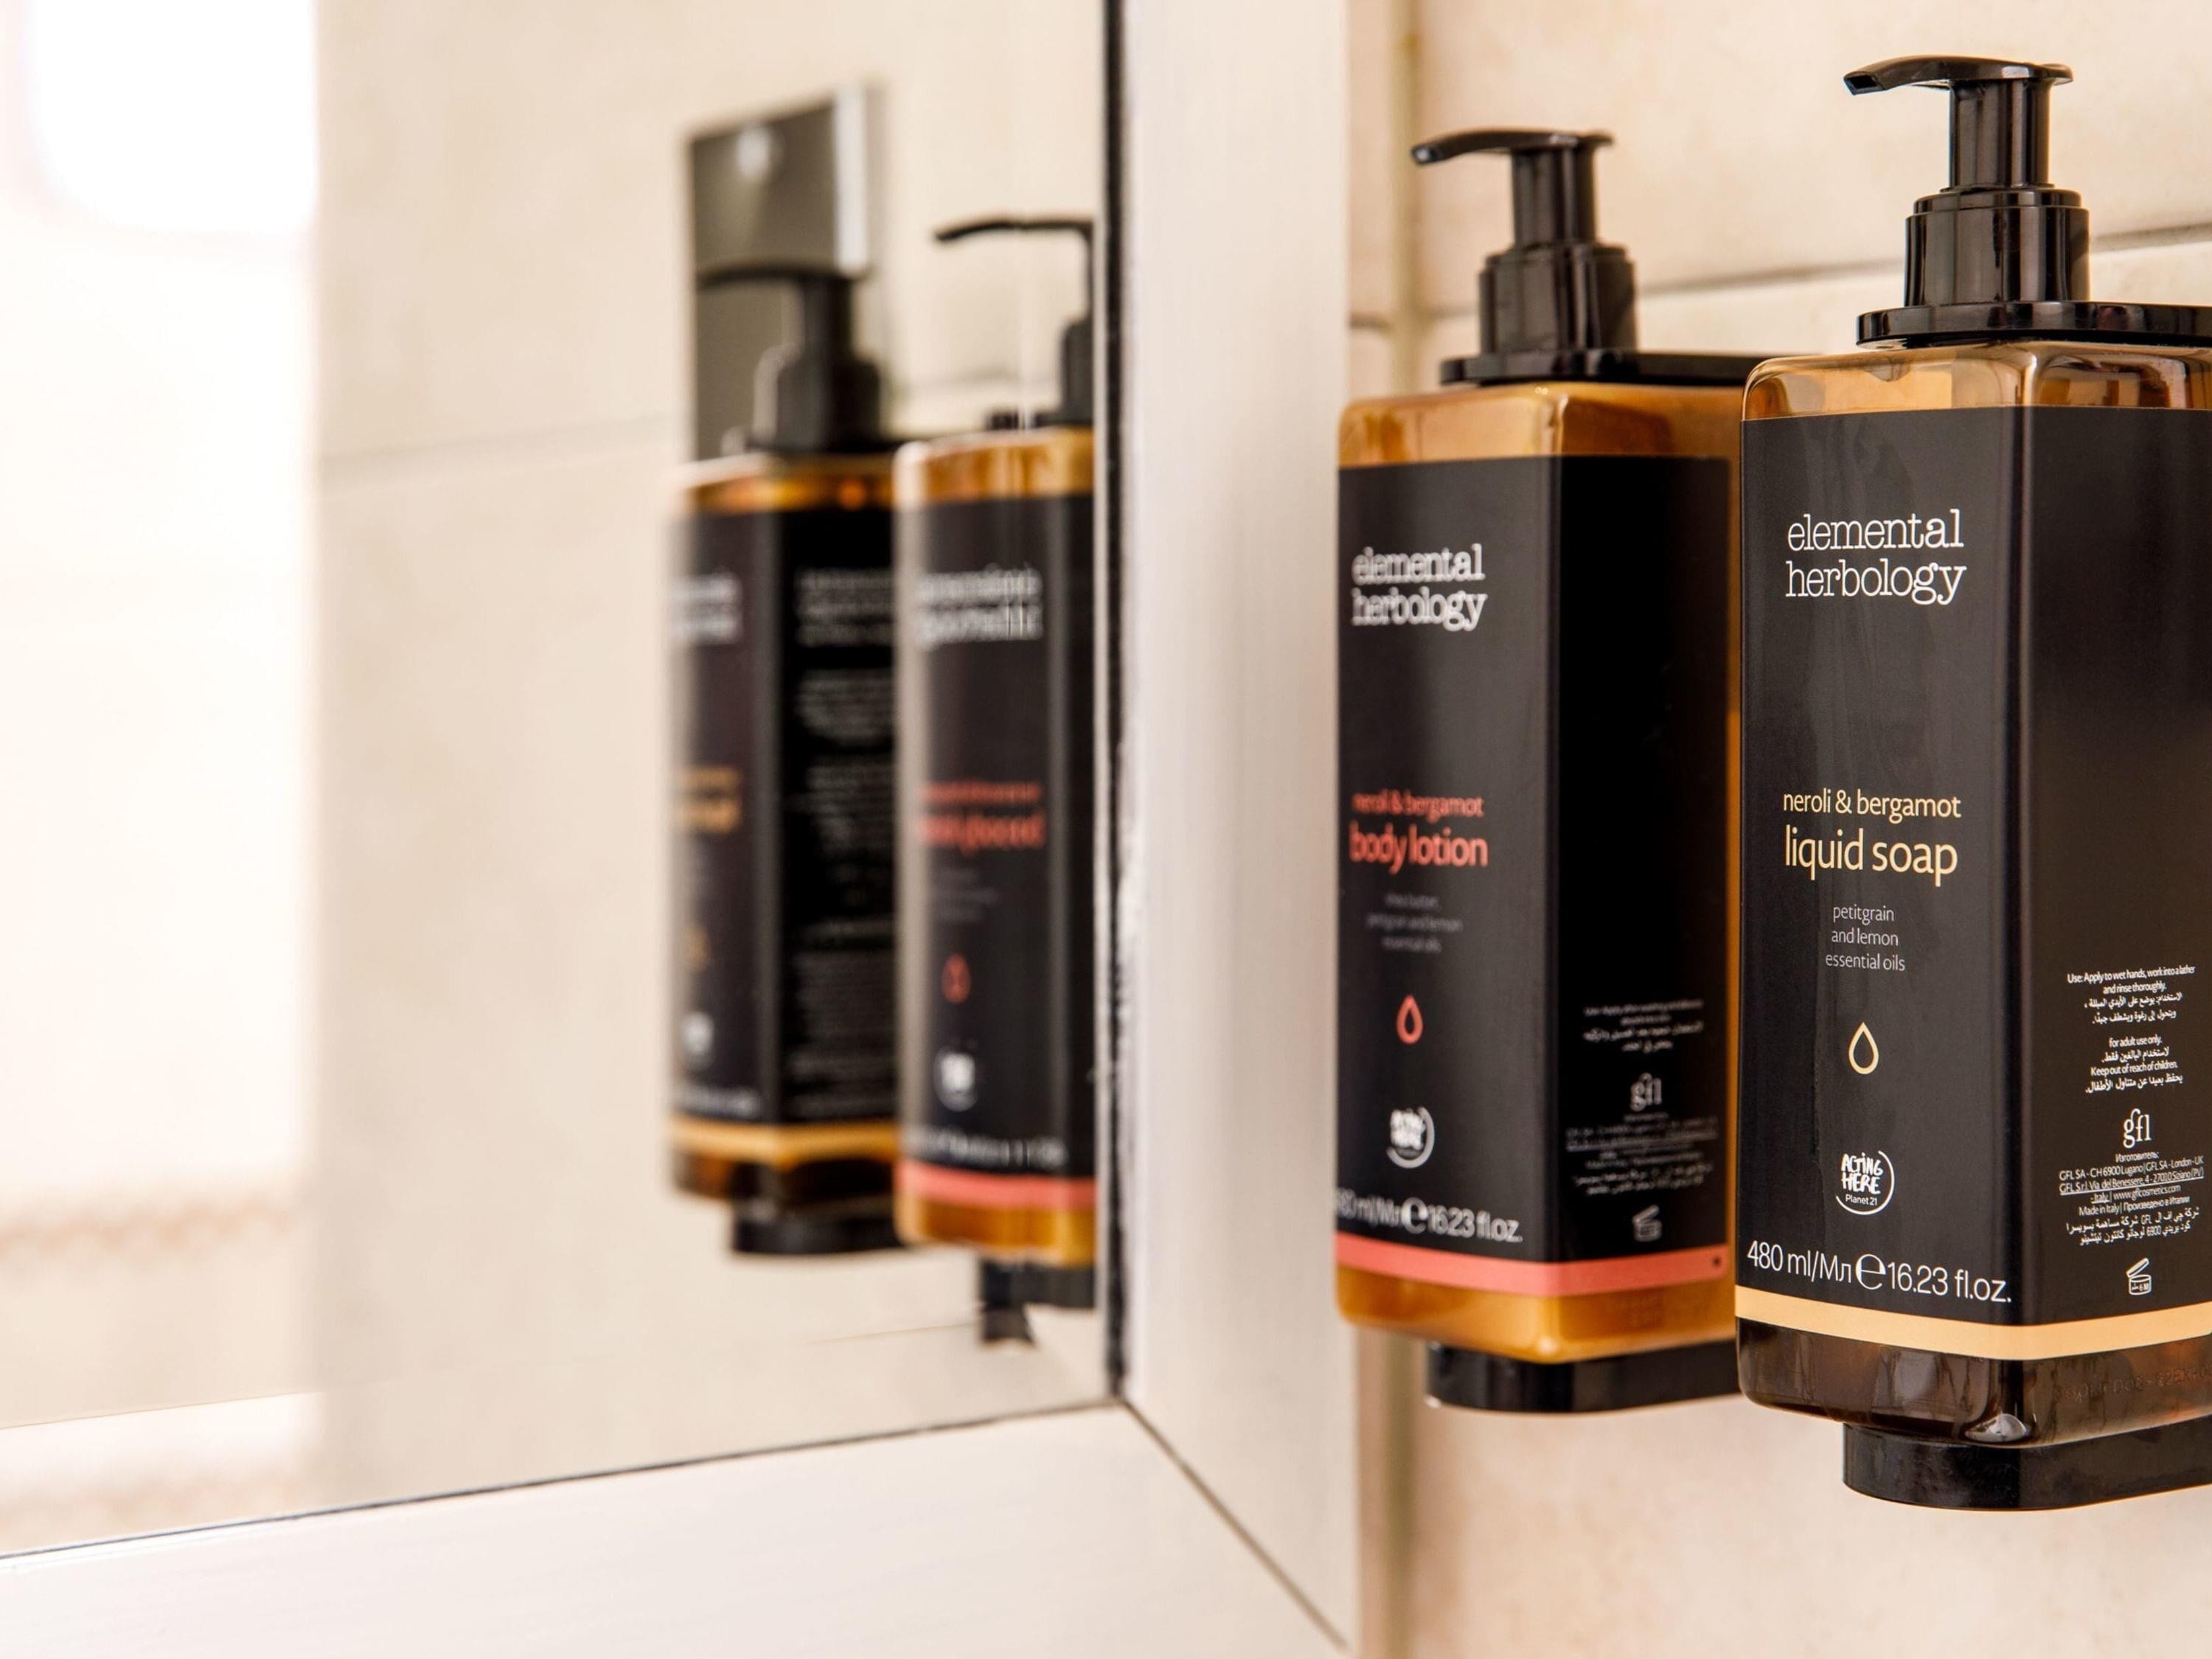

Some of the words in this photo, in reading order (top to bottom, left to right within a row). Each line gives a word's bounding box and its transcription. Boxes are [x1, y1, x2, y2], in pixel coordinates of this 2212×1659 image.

[1787, 509, 1964, 552] elemental
[1352, 543, 1486, 585] elemental
[1785, 558, 1967, 605] herbology
[1351, 586, 1488, 631] herbology
[1403, 790, 1484, 824] bergamot
[1783, 788, 1832, 813] neroli
[1835, 790, 1852, 815] &
[1857, 789, 1961, 824] bergamot
[1349, 820, 1408, 874] body
[1408, 824, 1489, 867] lotion
[1785, 824, 1864, 881] liquid
[1871, 841, 1958, 887] soap
[1833, 903, 1895, 925] petitgrain
[1832, 927, 1854, 943] and
[1857, 928, 1899, 946] lemon
[1826, 953, 1880, 970] essential
[1883, 955, 1905, 971] oils
[2084, 971, 2103, 984] Apply
[2104, 973, 2112, 981] to
[2112, 971, 2126, 981] wet
[2146, 967, 2163, 977] work
[2163, 967, 2175, 975] into
[2179, 964, 2195, 975] lather
[2103, 984, 2115, 994] and
[2117, 984, 2132, 992] rinse
[2132, 980, 2167, 993] thoroughly.
[2120, 1036, 2136, 1047] adult
[2136, 1037, 2147, 1046] use
[2090, 1065, 2109, 1077] Keep
[2109, 1065, 2121, 1075] out
[2121, 1062, 2129, 1074] of
[2129, 1062, 2147, 1073] reach
[2147, 1061, 2154, 1071] of
[2123, 1107, 2152, 1149] gfl
[1841, 1171, 1881, 1194] HERE
[2059, 1170, 2075, 1181] GFL
[2076, 1169, 2086, 1179] SA
[2103, 1166, 2121, 1177] 6900
[2059, 1183, 2075, 1193] GFL
[2089, 1180, 2101, 1191] Via
[1846, 1194, 1869, 1205] Planet
[1870, 1197, 1878, 1206] 21
[2078, 1206, 2099, 1217] Made
[2099, 1206, 2105, 1214] in
[2106, 1203, 2120, 1216] Italy
[1747, 1240, 1784, 1272] 480
[1888, 1261, 1948, 1296] 16.23
[1954, 1268, 2012, 1303] fl.oz.
